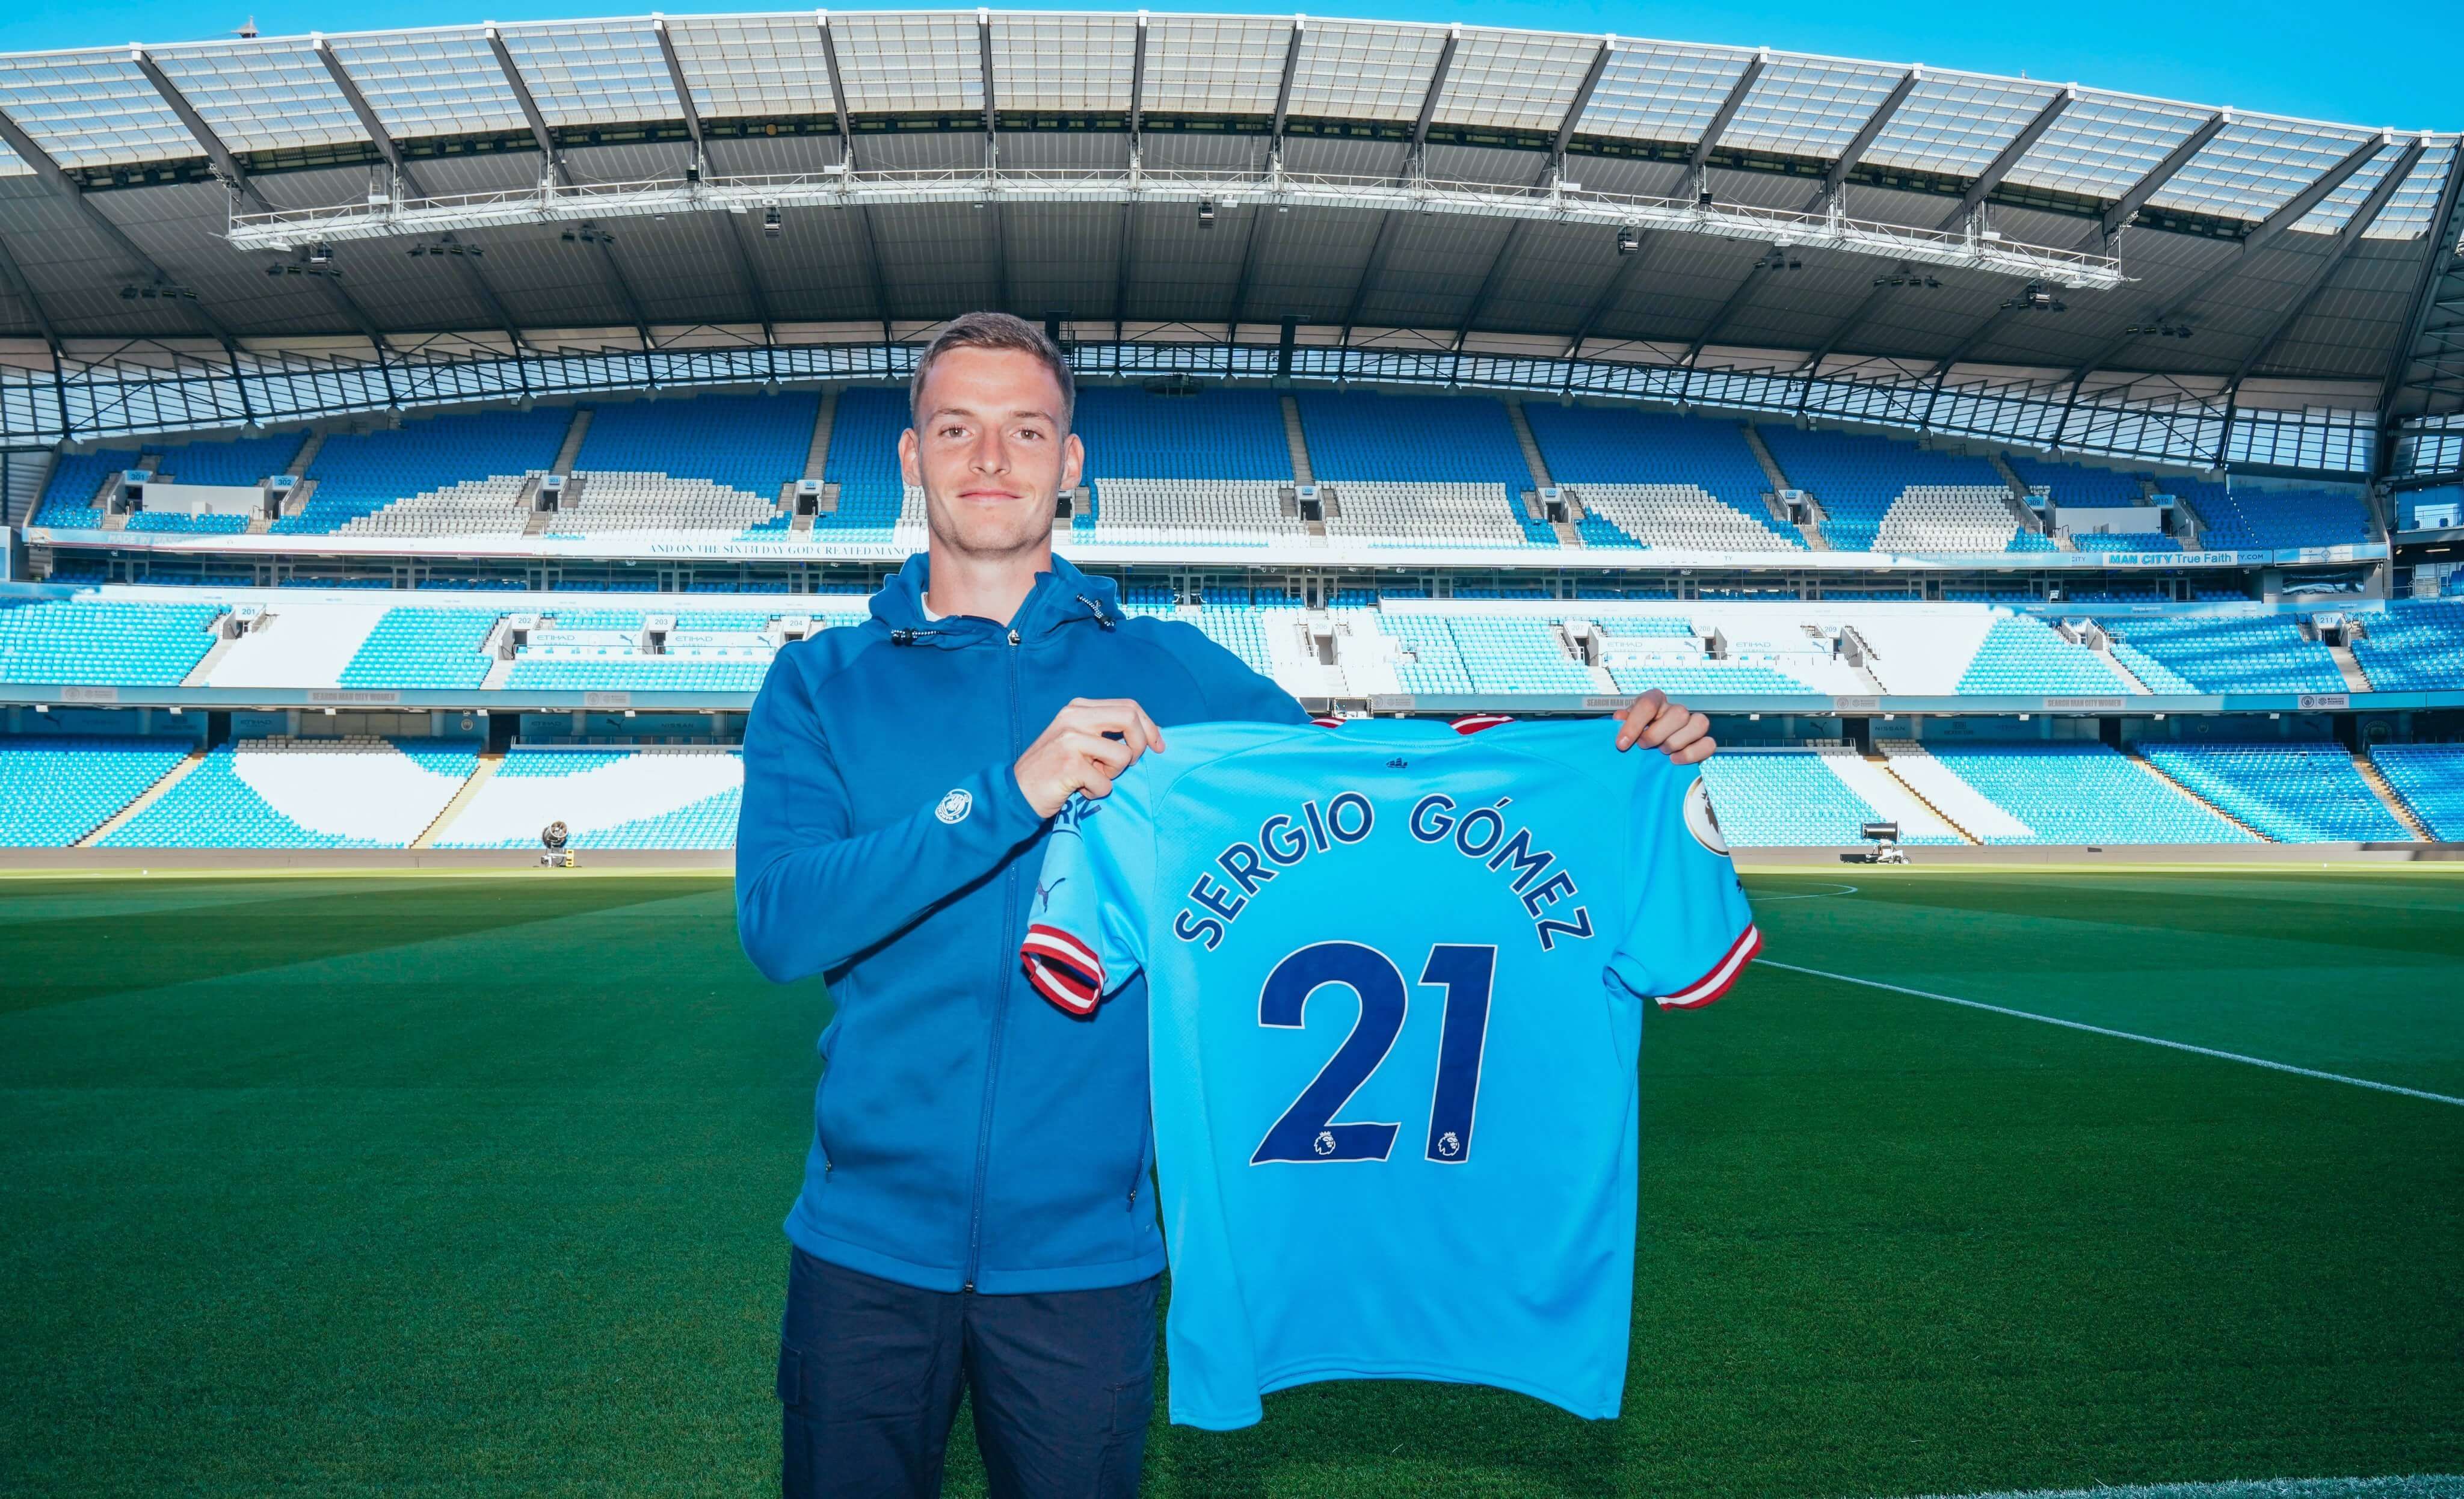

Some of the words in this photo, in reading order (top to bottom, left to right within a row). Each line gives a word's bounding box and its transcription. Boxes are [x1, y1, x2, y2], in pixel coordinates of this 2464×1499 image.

[650, 544, 673, 553] AND
[676, 544, 693, 553] ON
[698, 545, 718, 553] THE
[723, 545, 758, 553] SIXTH
[762, 546, 784, 554] DAY
[788, 546, 813, 555] GOD
[817, 546, 871, 555] CREATED
[2109, 555, 2138, 564] MAN
[2142, 554, 2173, 565] CITY
[2175, 553, 2201, 563] True
[2204, 553, 2231, 563] Faith
[312, 692, 337, 701] SEARCH
[338, 692, 354, 701] MAN
[354, 692, 369, 701] CITY
[369, 693, 395, 701] WOMEN
[1587, 698, 1609, 707] SEARCH
[1173, 791, 1375, 953] SERGIO
[1408, 793, 1595, 952] GÓMEZ
[1249, 940, 1498, 1167] 21
